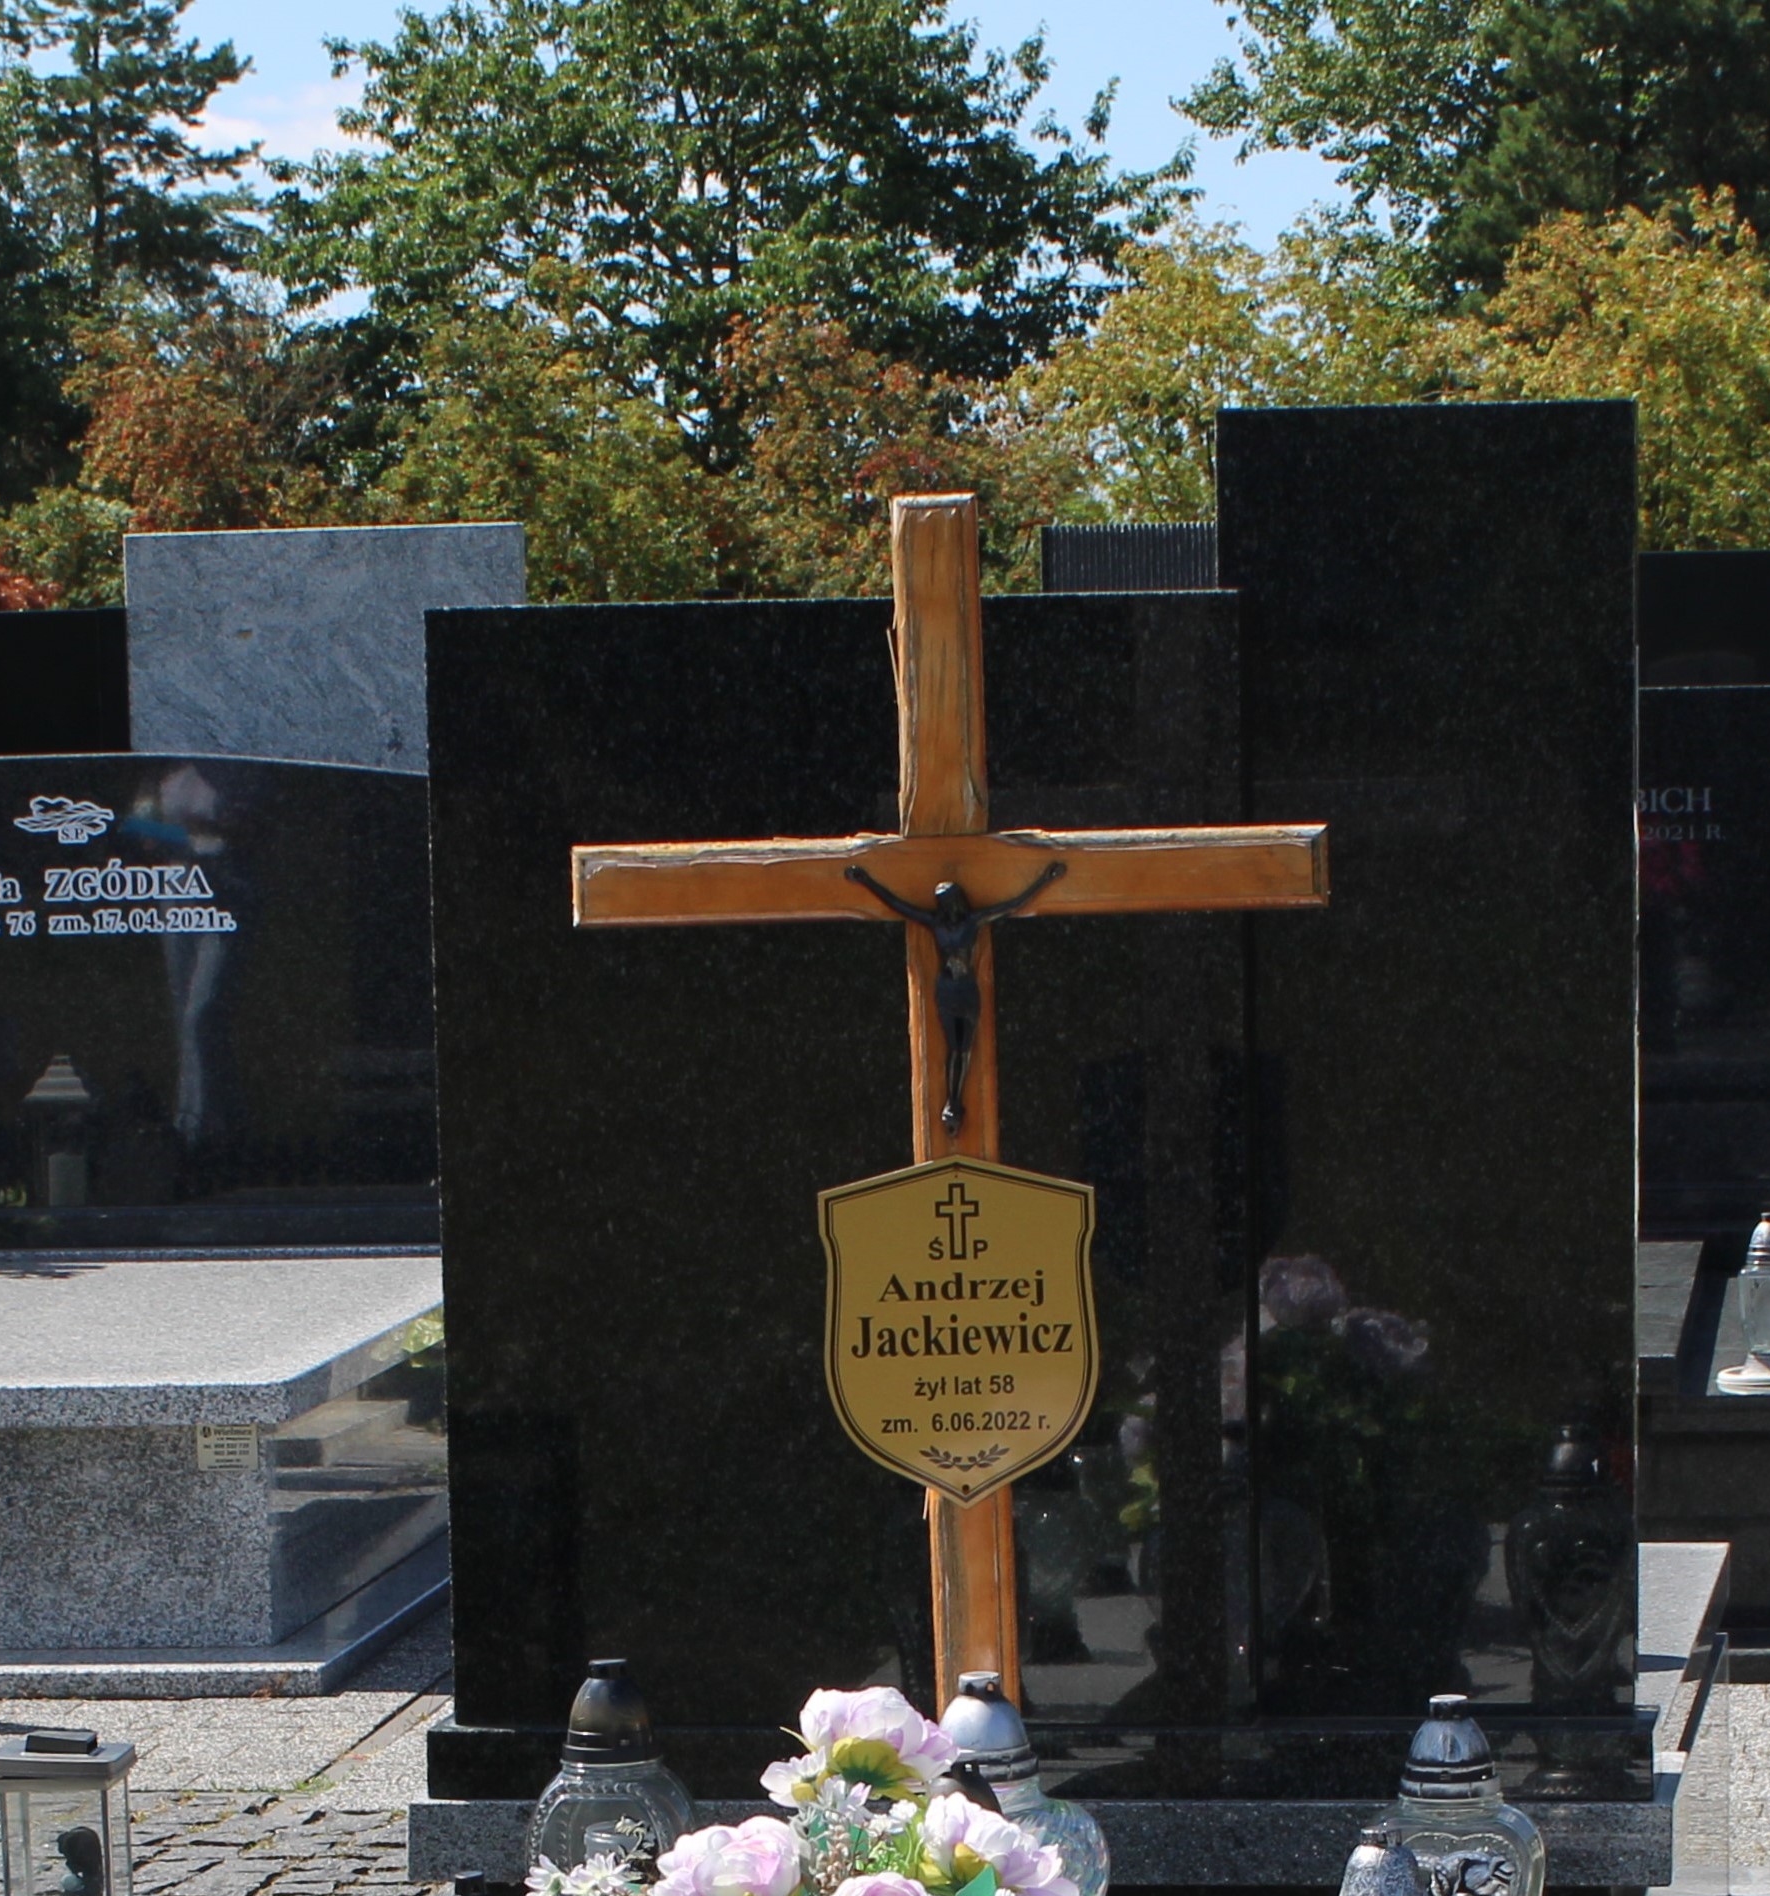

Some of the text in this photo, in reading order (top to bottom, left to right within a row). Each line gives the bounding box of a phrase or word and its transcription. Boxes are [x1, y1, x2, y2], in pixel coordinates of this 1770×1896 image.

[43, 857, 214, 902] ZGÓDKA
[6, 911, 36, 936] 76
[973, 1240, 988, 1259] P
[879, 1270, 1045, 1306] Andrzej
[851, 1312, 1073, 1358] Jackiewicz
[914, 1375, 1015, 1401] żył lat 58
[881, 1412, 1050, 1433] zm. 6.06.2022 r.
